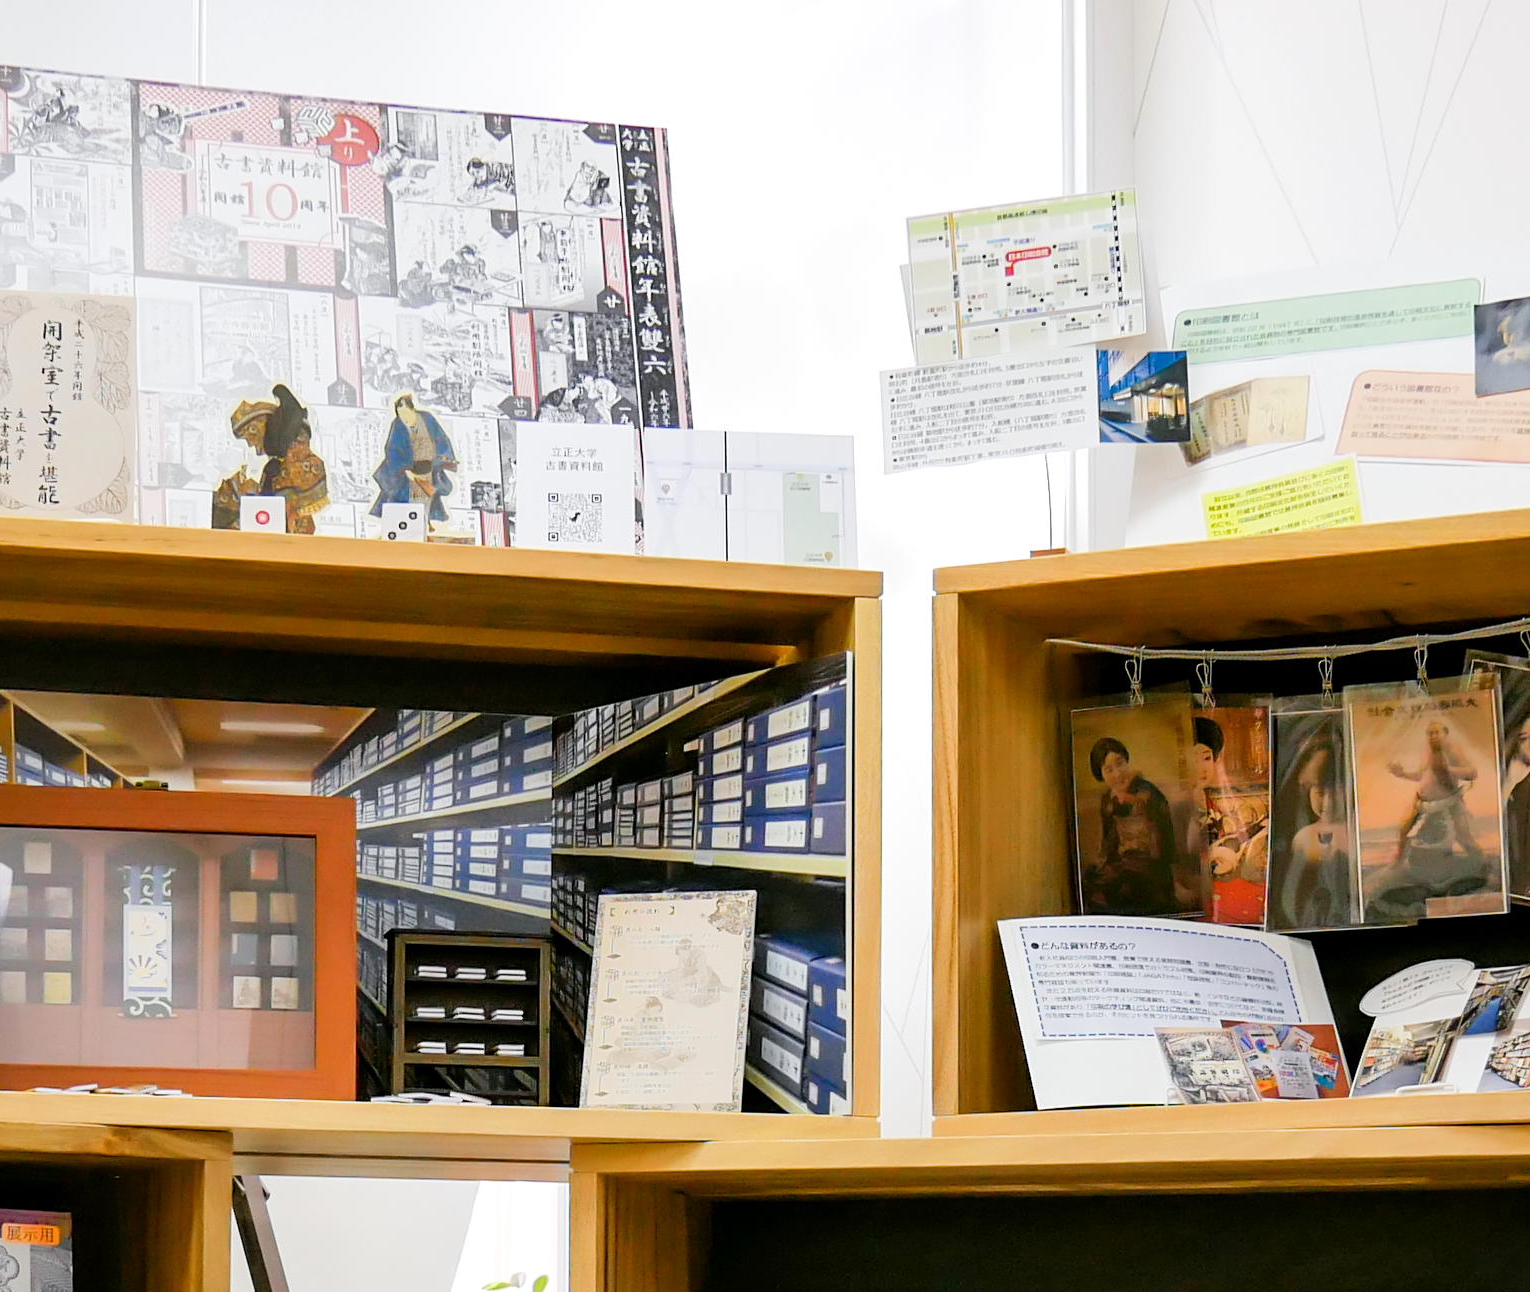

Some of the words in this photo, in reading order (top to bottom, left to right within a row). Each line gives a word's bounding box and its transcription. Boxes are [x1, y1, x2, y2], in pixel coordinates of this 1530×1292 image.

[335, 118, 365, 160] 上り
[215, 153, 322, 179] 古書資料館
[214, 181, 330, 222] 開館10周年
[15, 408, 27, 461] 立正大学
[551, 447, 598, 459] 立正大学
[545, 461, 605, 472] 古書資料館
[5, 1227, 56, 1244] 展示用
